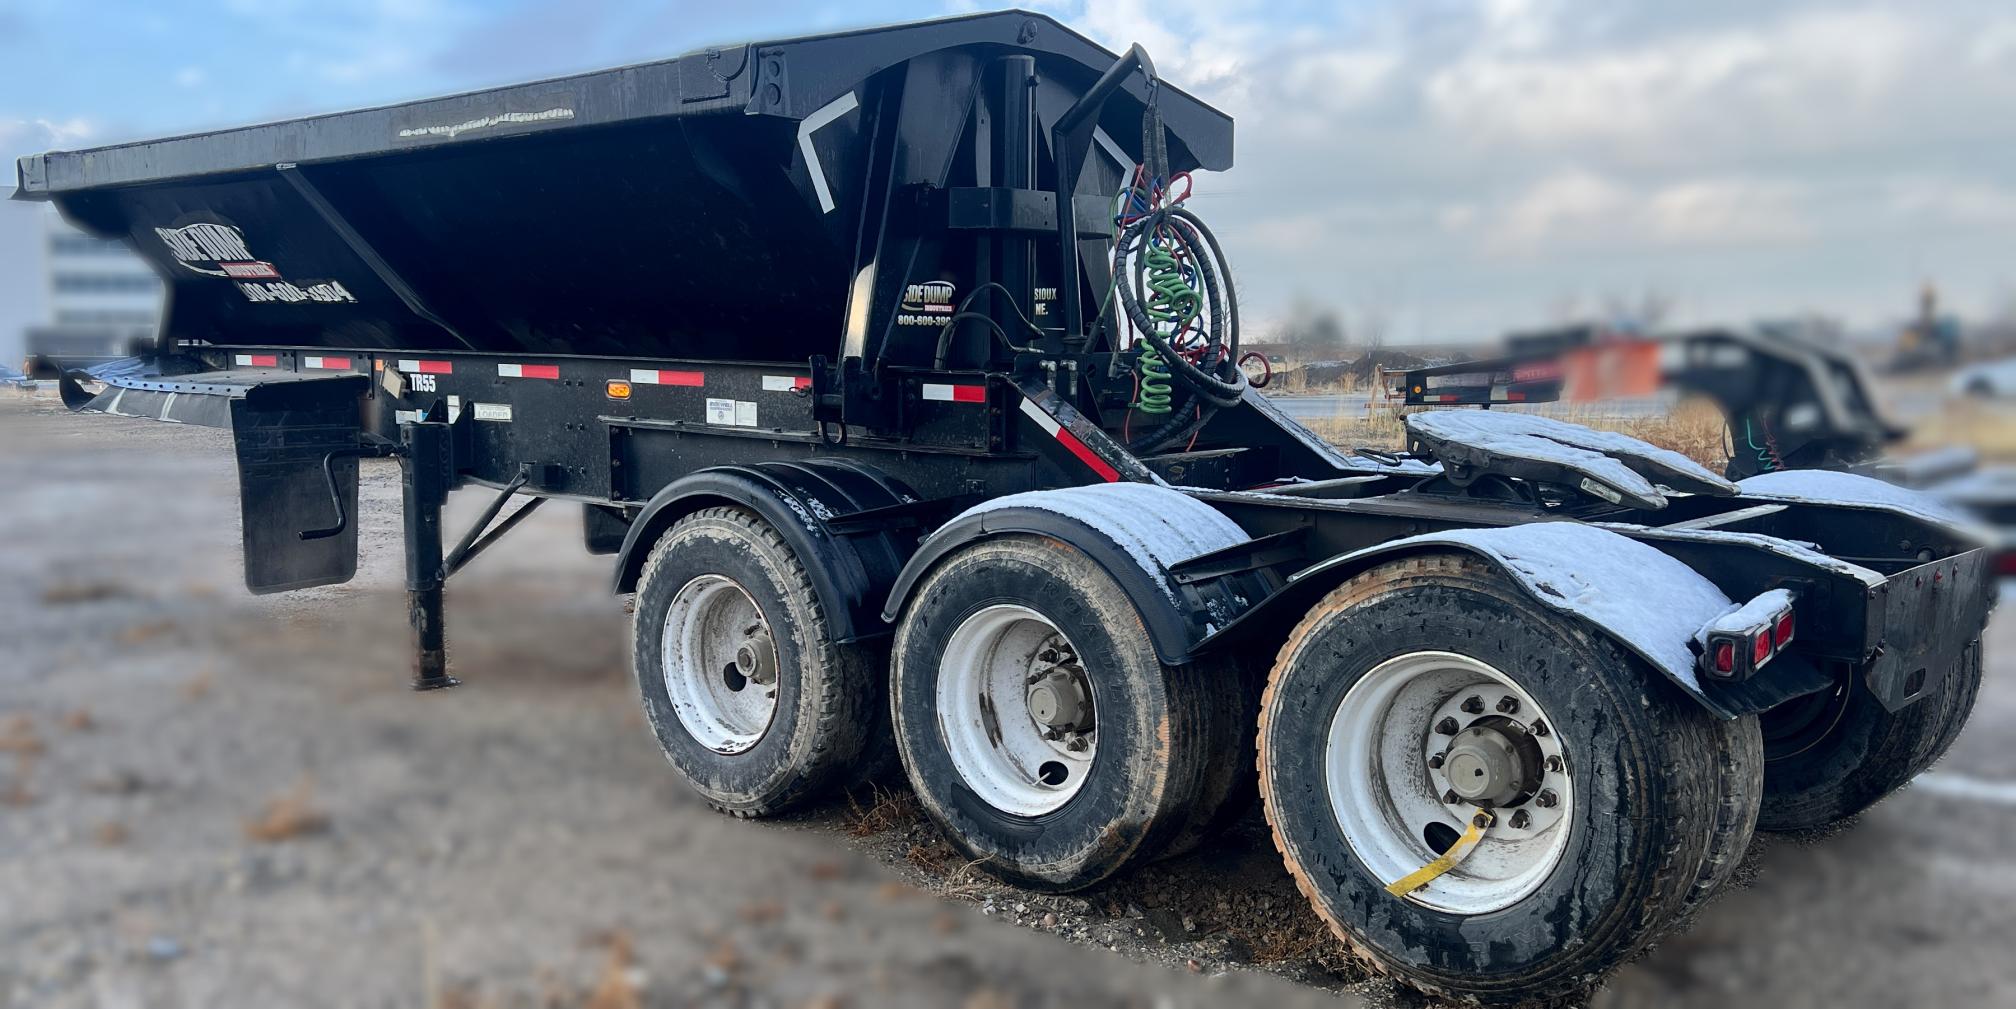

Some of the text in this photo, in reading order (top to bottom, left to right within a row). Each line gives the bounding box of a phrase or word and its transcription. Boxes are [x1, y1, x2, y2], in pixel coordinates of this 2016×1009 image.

[154, 225, 256, 261] SIDE DUMP
[903, 284, 953, 304] SIDE DUMP
[1034, 287, 1057, 301] SIOUX
[897, 314, 952, 327] 800-600-390
[410, 373, 436, 393] TR55
